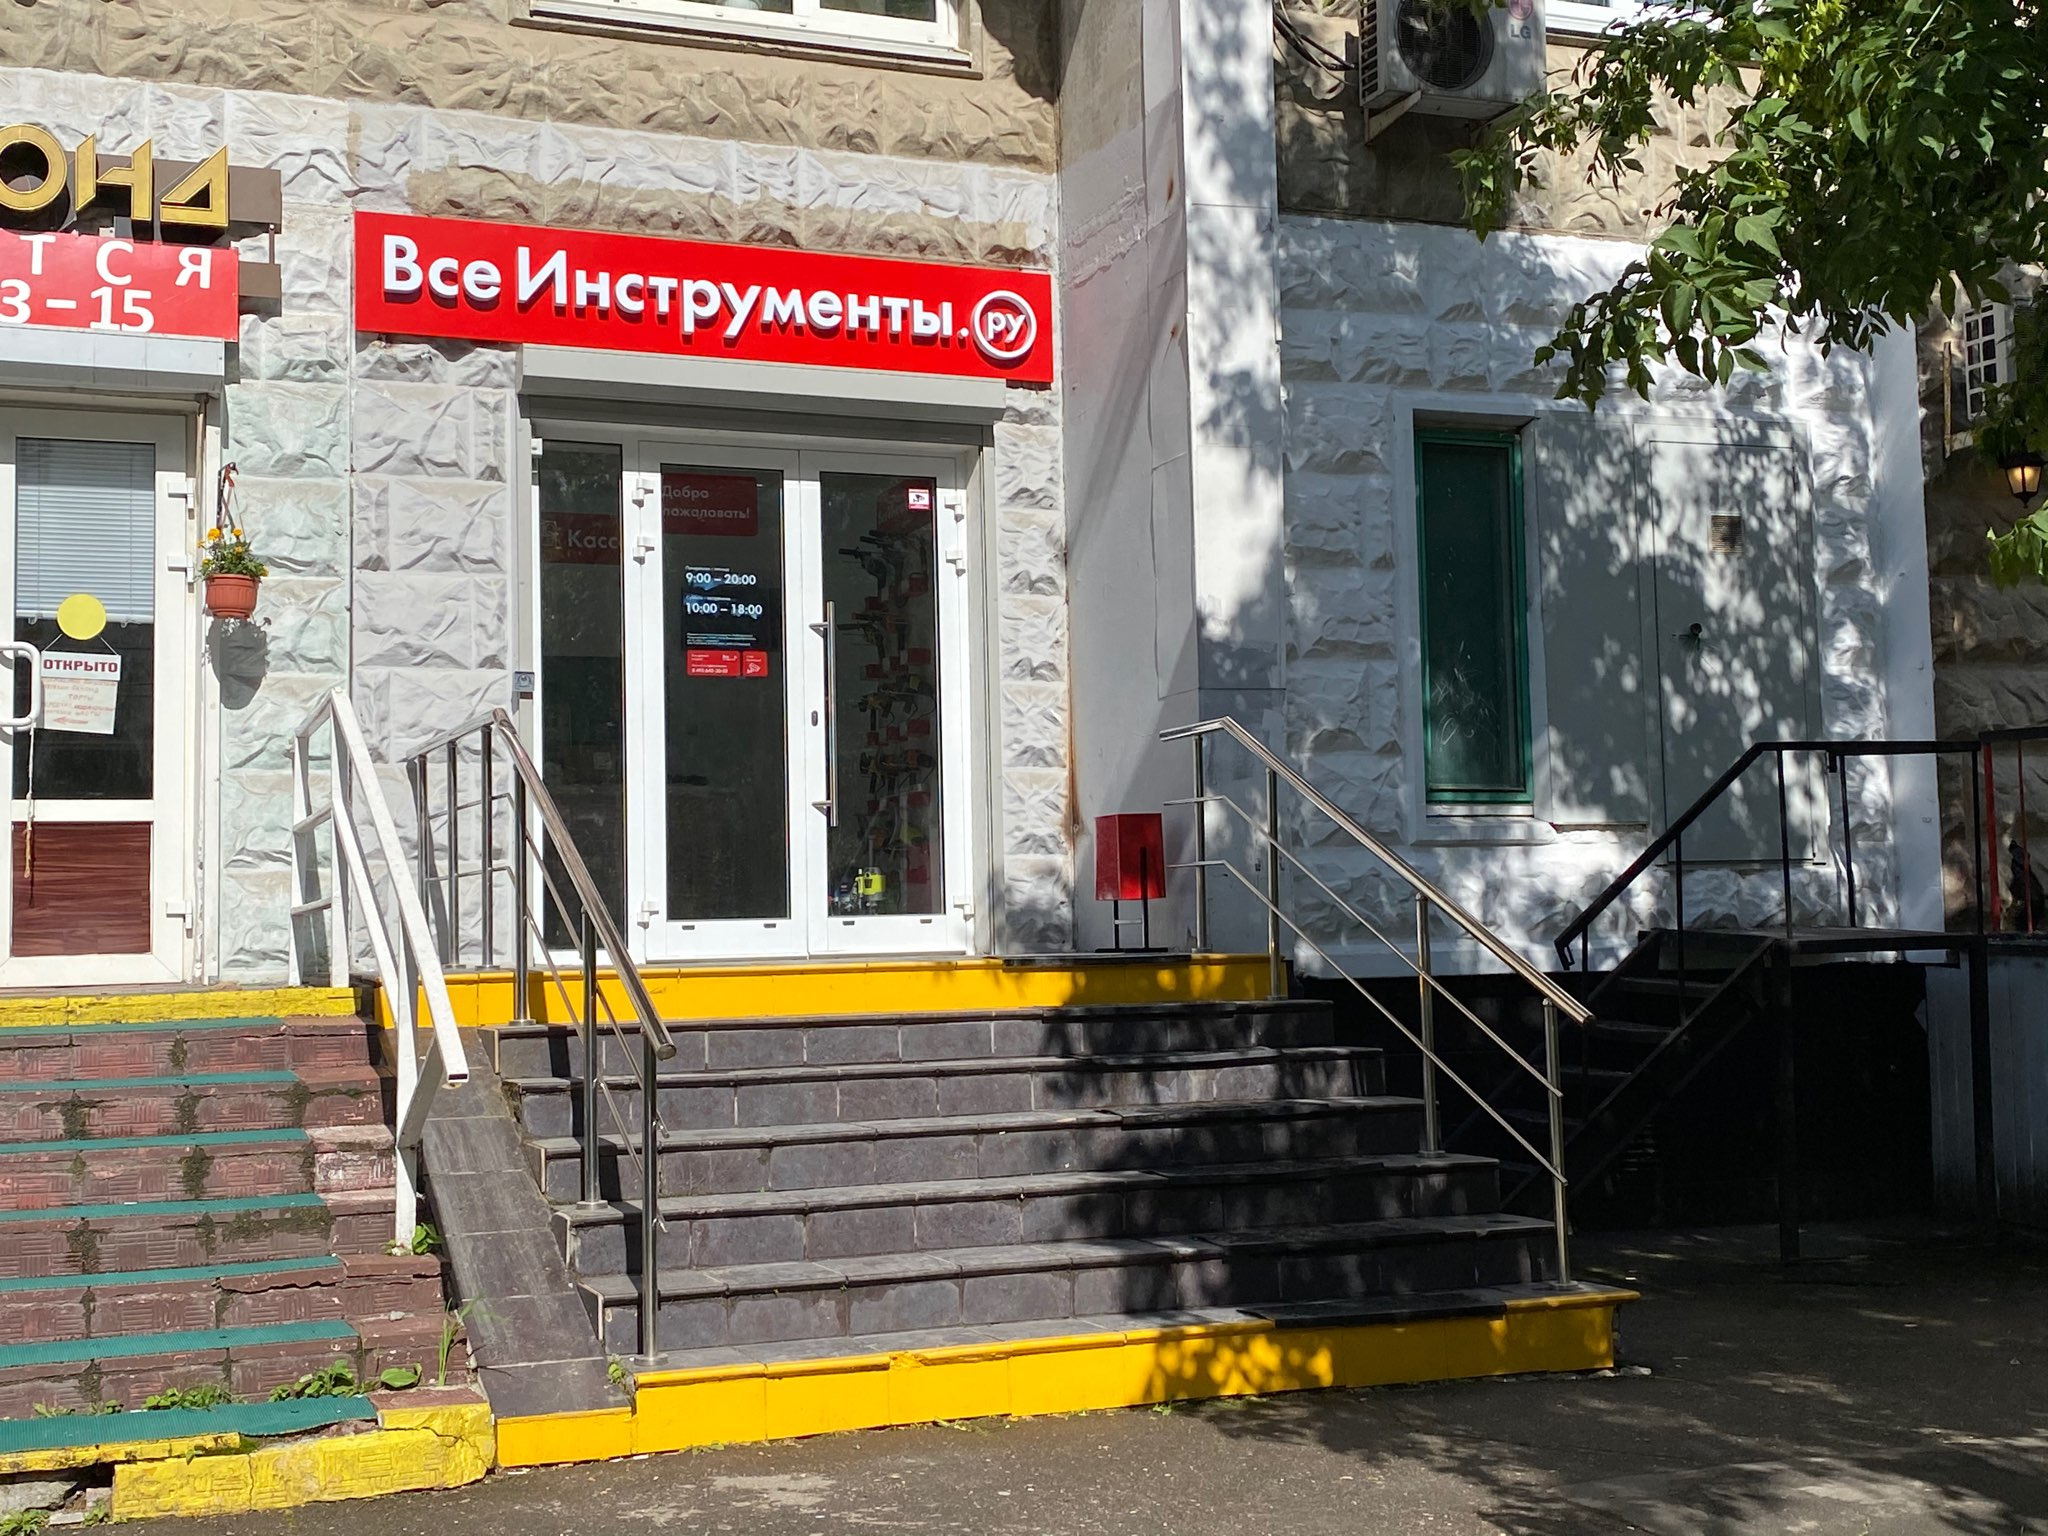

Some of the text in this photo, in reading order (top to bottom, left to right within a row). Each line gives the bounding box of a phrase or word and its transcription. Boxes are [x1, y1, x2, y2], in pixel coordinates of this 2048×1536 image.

[1510, 24, 1531, 38] LG
[383, 235, 502, 298] Все
[662, 484, 710, 500] Добро
[685, 572, 711, 584] 9:00
[723, 573, 757, 585] 20:00
[685, 602, 718, 614] 10:00
[730, 603, 763, 615] 18:00
[43, 659, 119, 673] ОТКРЫТО
